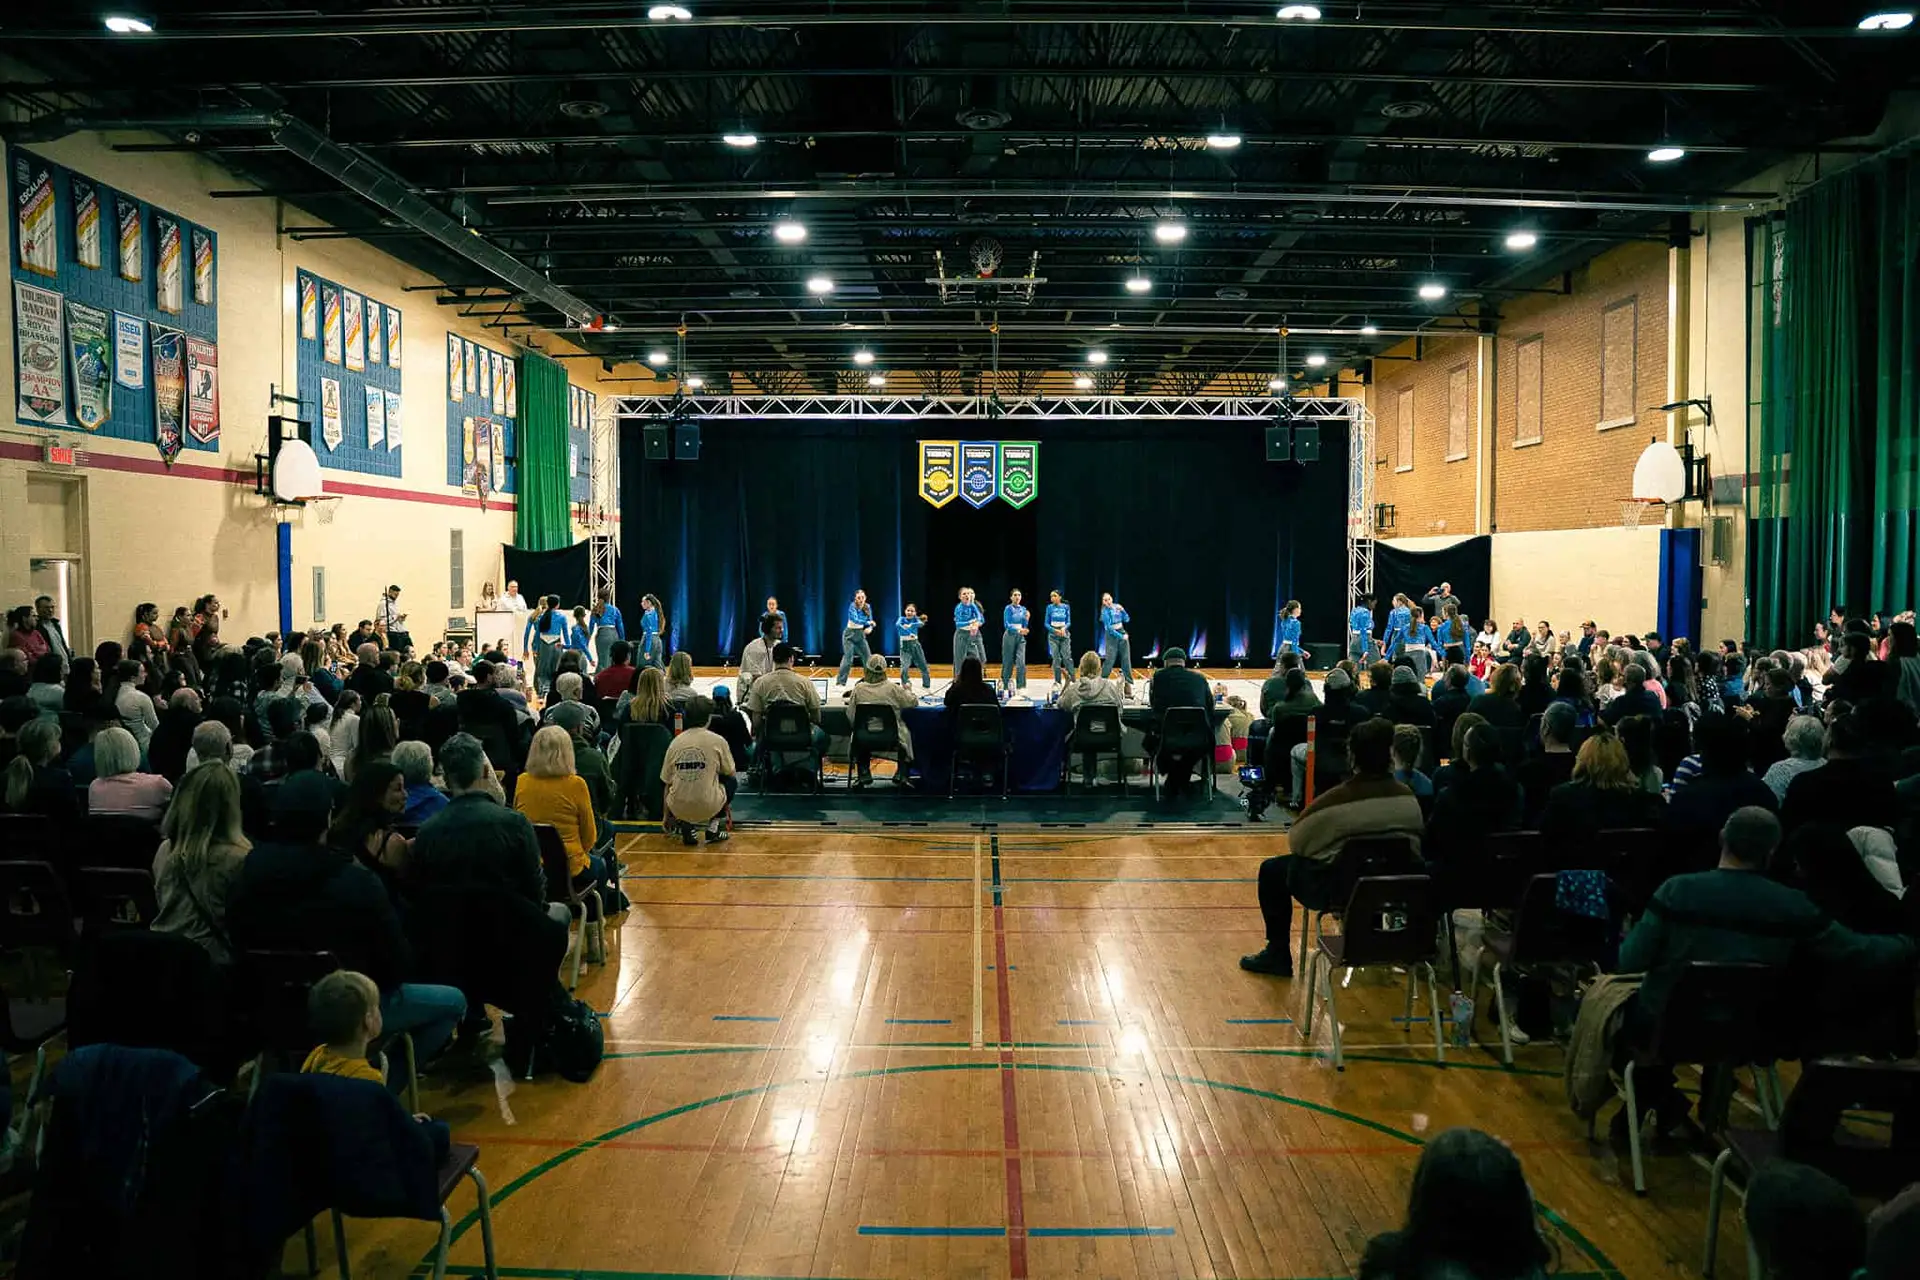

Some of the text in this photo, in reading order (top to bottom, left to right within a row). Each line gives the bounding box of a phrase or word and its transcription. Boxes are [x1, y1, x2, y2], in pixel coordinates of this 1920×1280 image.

[21, 300, 57, 320] BANTAM
[26, 320, 52, 333] ROYAL
[19, 328, 60, 345] BRASSARD
[31, 384, 51, 398] AA
